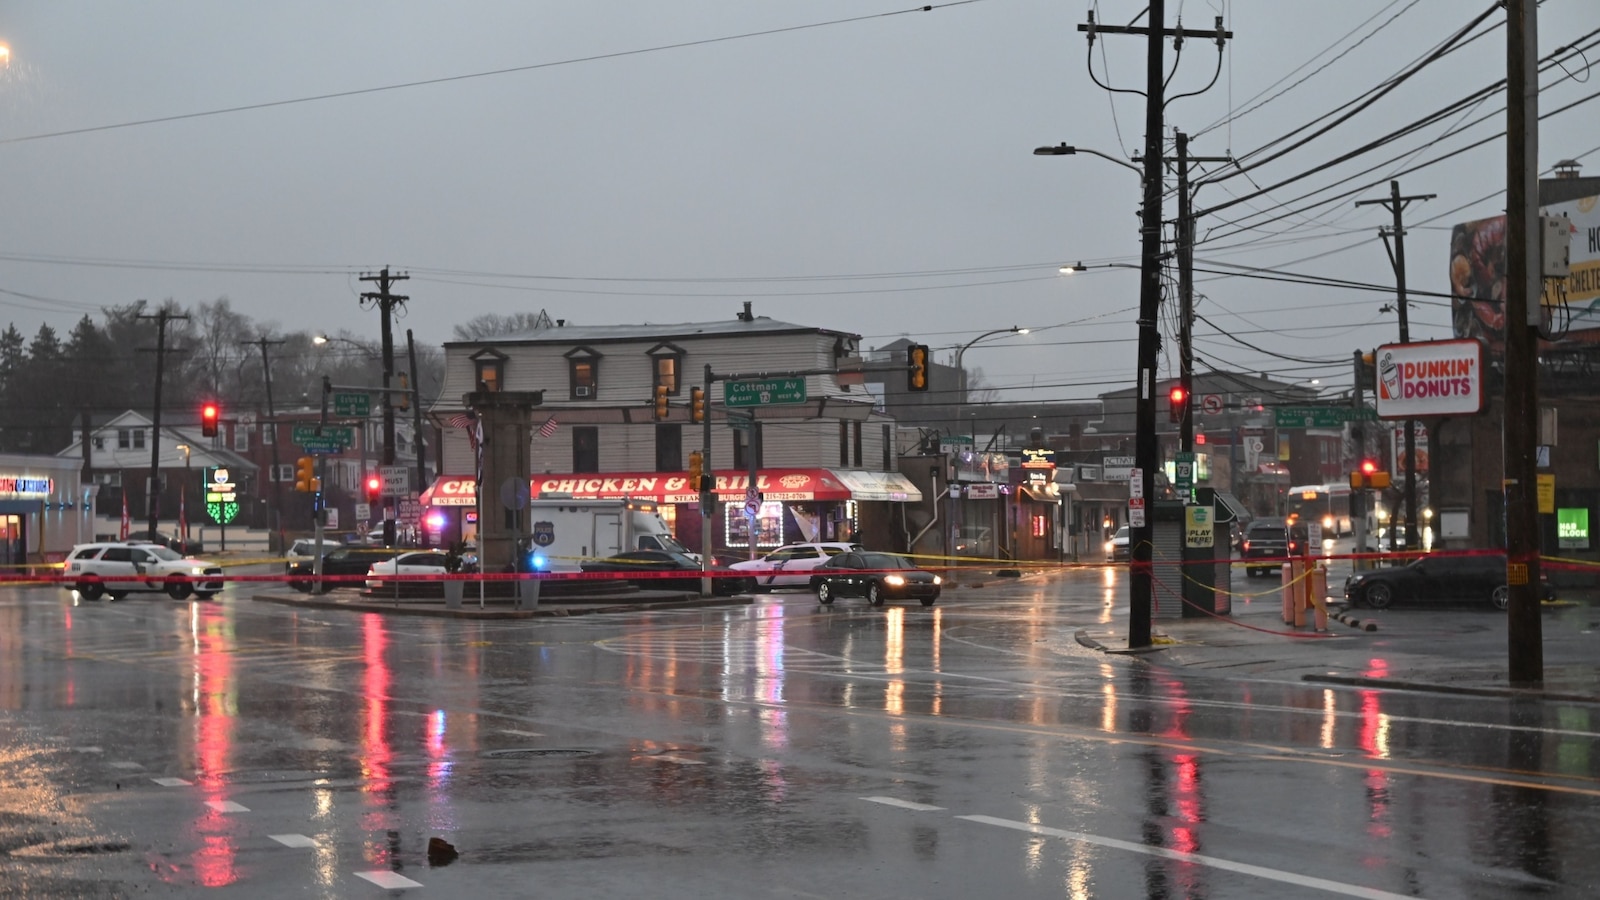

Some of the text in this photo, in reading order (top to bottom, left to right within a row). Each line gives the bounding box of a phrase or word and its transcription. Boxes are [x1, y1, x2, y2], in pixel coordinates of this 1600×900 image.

[1404, 358, 1474, 379] DUNKIN'
[733, 381, 797, 392] Cottman Av
[1404, 377, 1471, 399] DONUTS
[762, 394, 769, 402] 73
[1281, 409, 1320, 417] Cottman
[1396, 429, 1429, 437] PZA
[1178, 466, 1189, 475] 73
[541, 478, 658, 493] CHICKEN
[664, 477, 687, 490] &
[715, 475, 771, 489] RILL
[1559, 522, 1577, 530] H&R
[1559, 529, 1587, 537] BLOCK
